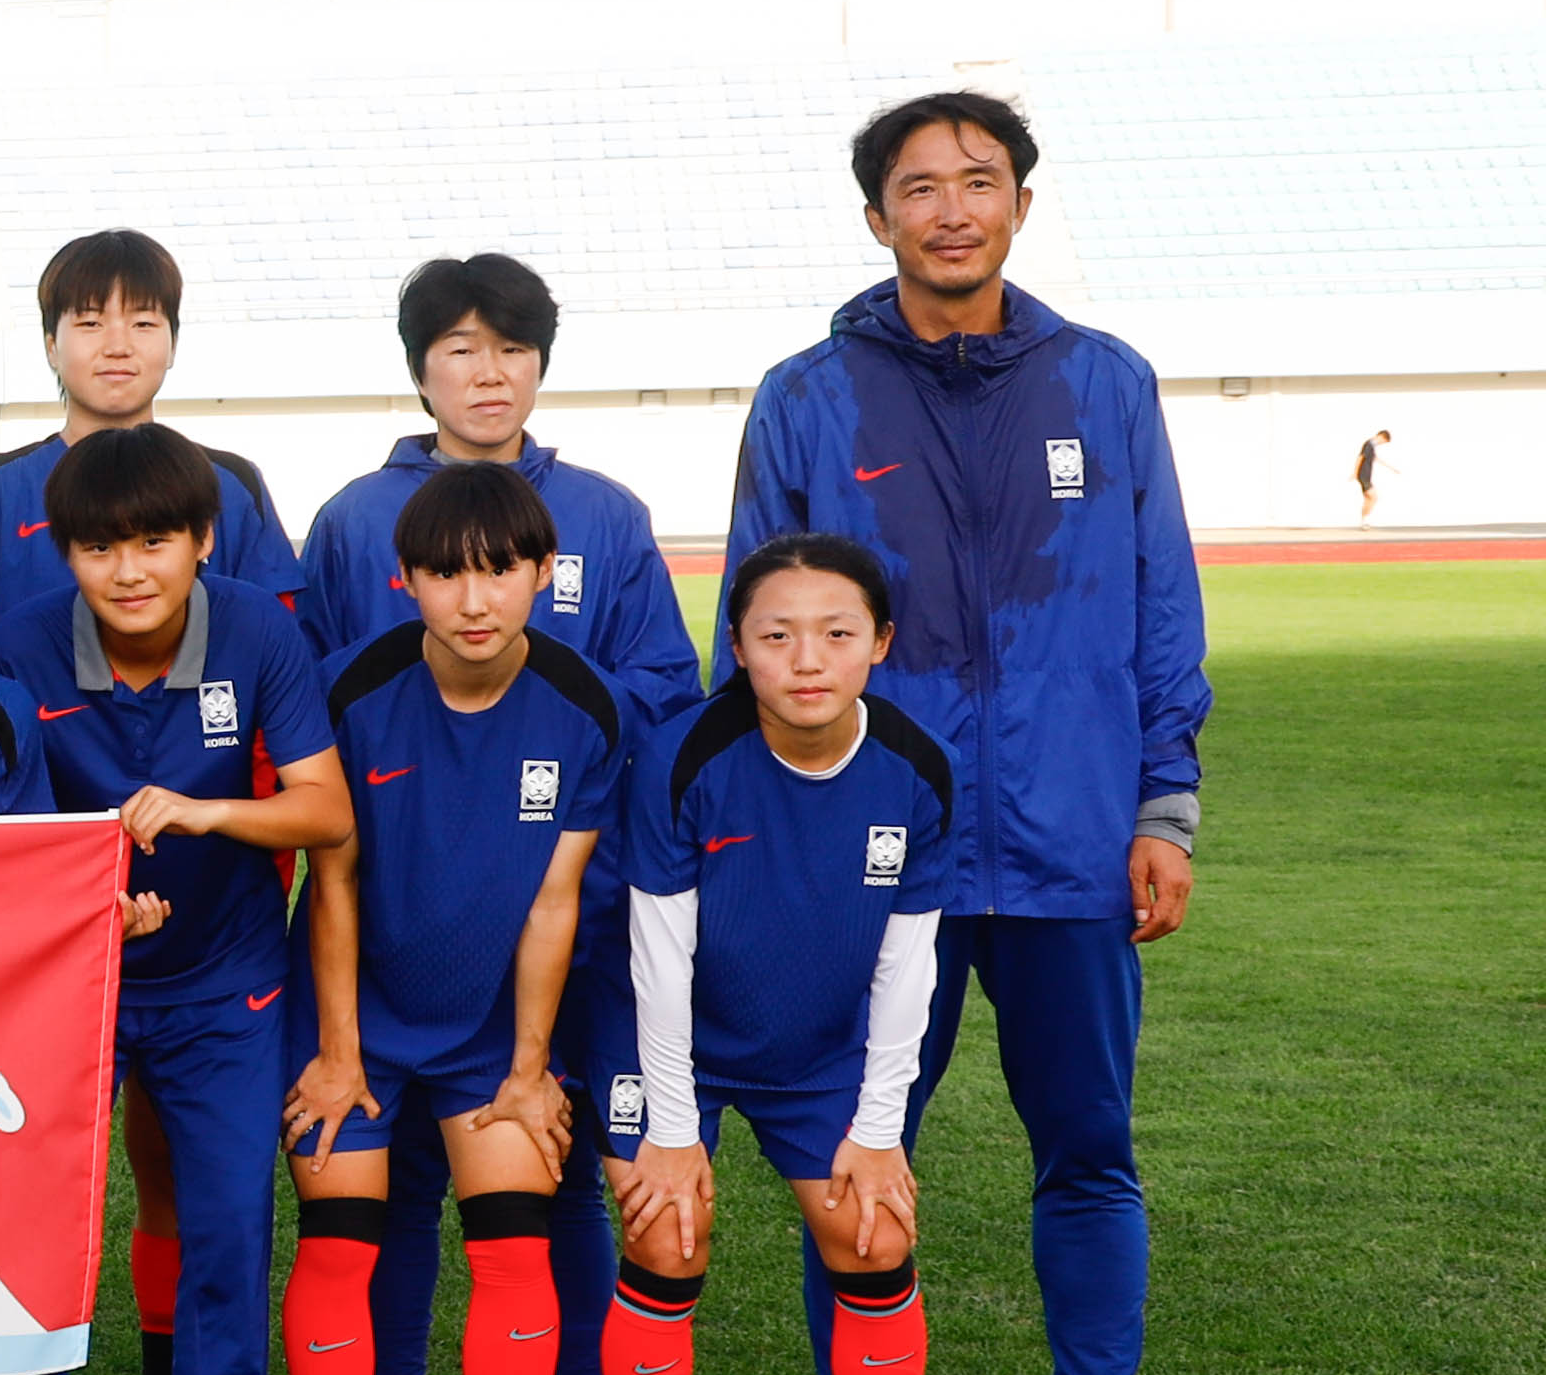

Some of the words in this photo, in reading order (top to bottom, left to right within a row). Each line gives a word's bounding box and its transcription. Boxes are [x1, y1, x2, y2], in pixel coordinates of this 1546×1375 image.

[1051, 489, 1084, 499] KOREA
[204, 736, 239, 748] KOREA
[519, 812, 554, 822] KOREA
[863, 876, 899, 886] KOREA
